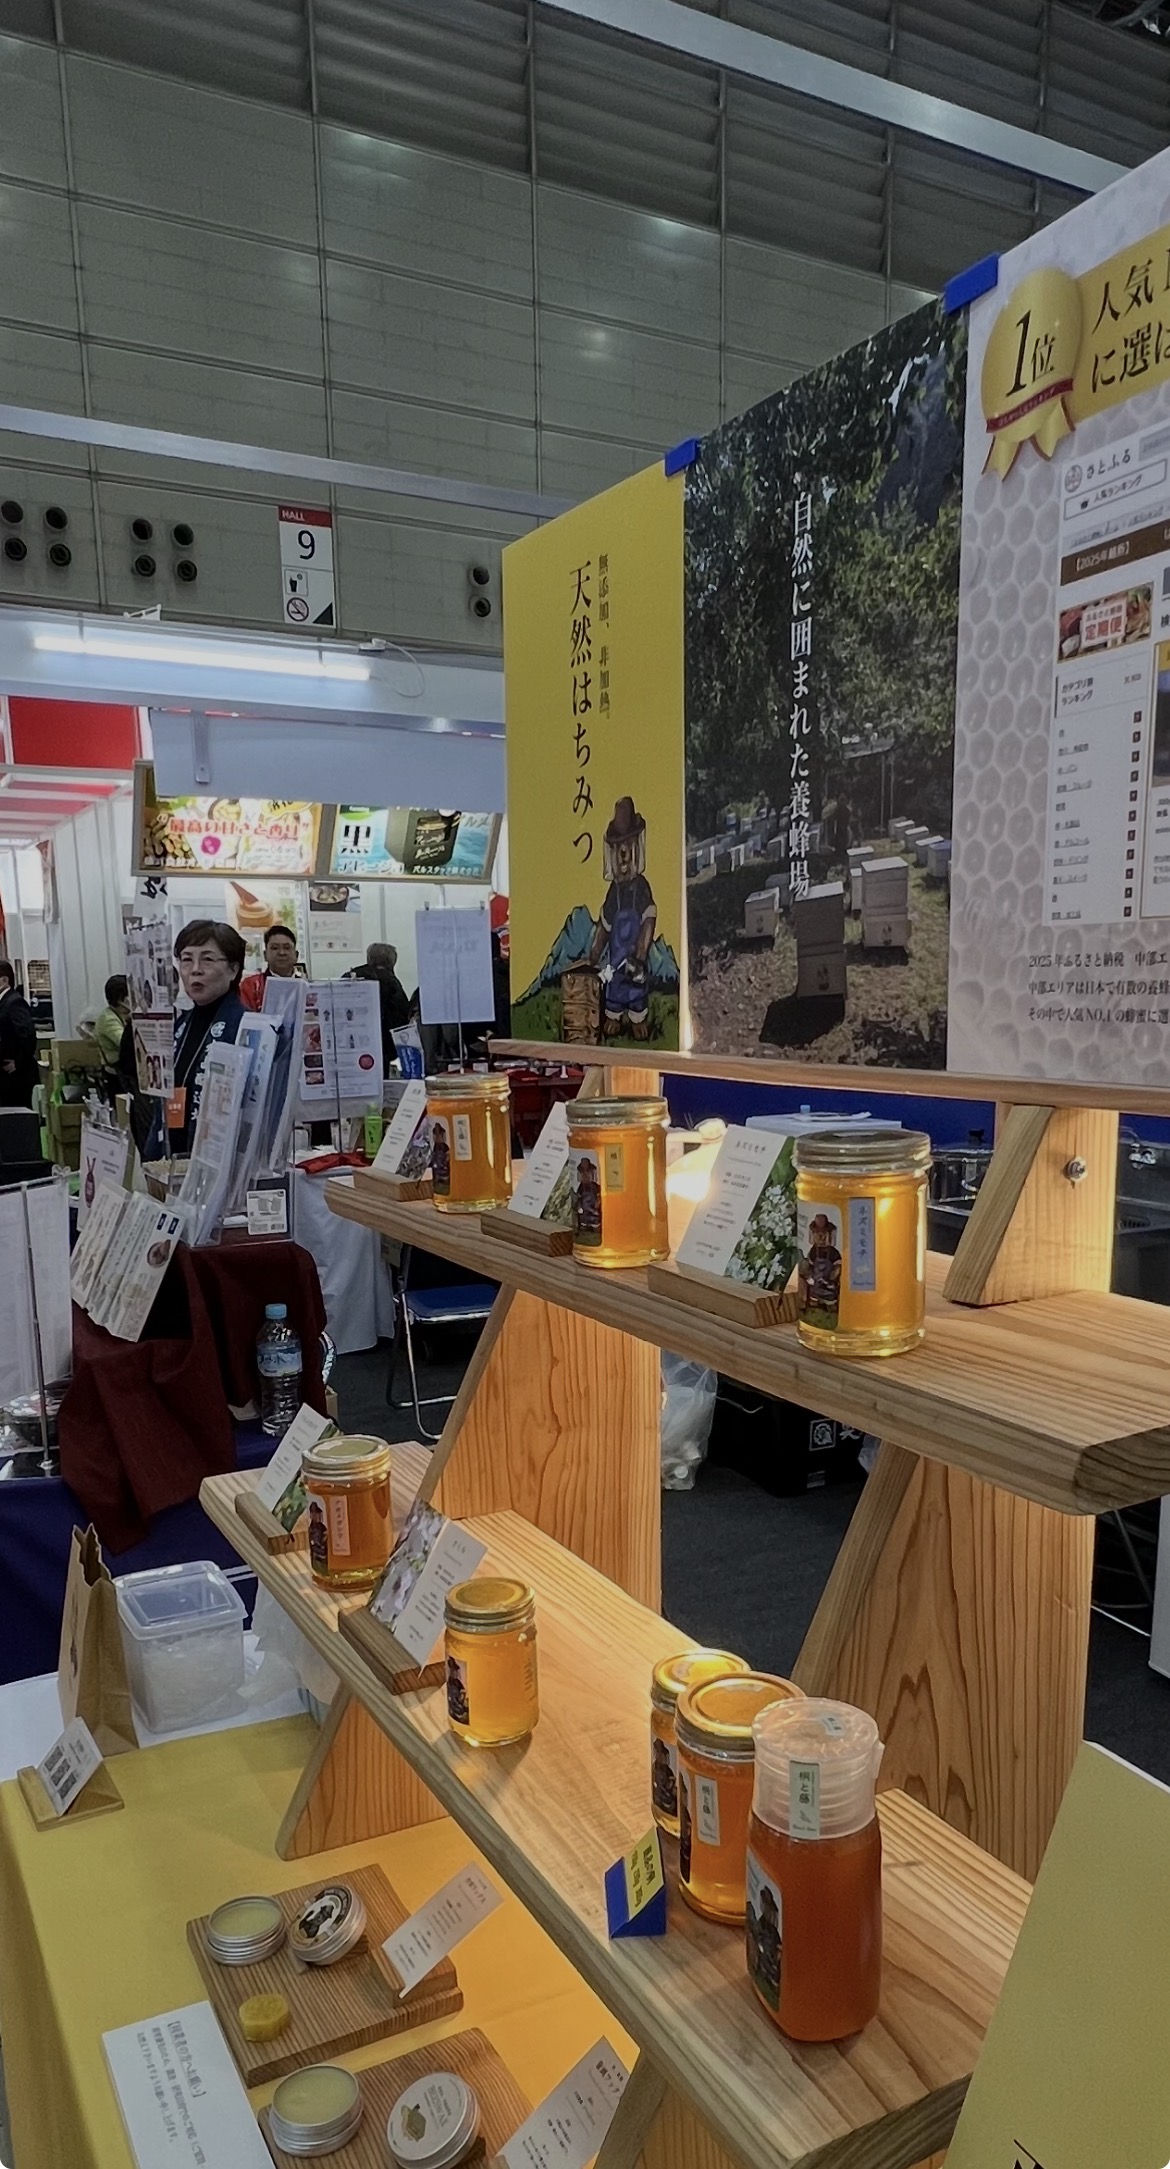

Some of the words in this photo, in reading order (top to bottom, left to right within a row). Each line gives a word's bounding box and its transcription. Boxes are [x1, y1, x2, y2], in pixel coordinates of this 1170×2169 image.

[1091, 247, 1170, 335] 人気
[1005, 309, 1055, 398] 1位
[1086, 448, 1132, 480] さとふる
[281, 509, 306, 522] HALL
[298, 529, 316, 560] 9
[569, 560, 594, 864] 天然はちみつ
[788, 491, 813, 898] 自然に囲まれた養蜂場
[1028, 951, 1124, 968] 2025年ふるさと納税
